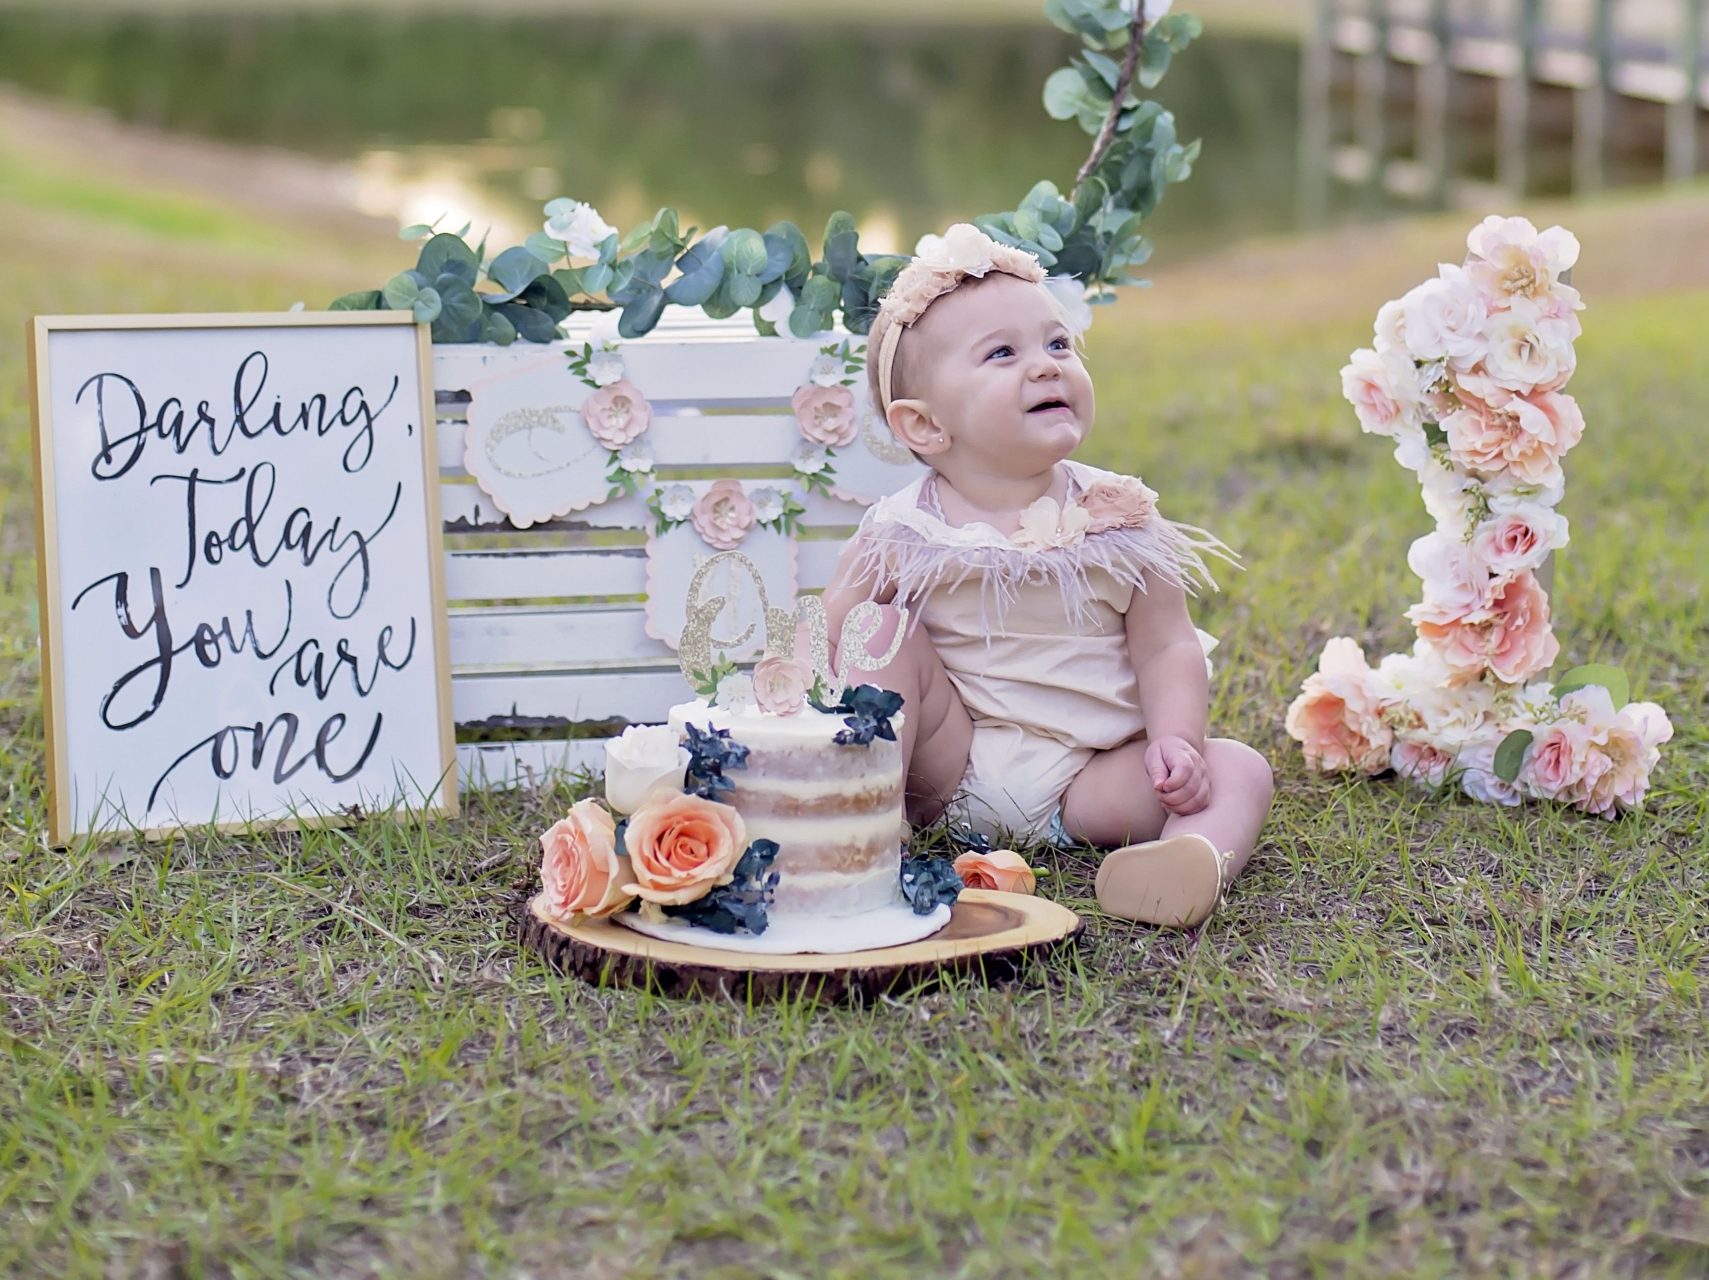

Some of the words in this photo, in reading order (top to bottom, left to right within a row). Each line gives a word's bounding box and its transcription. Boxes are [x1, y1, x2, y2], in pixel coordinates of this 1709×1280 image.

[75, 350, 414, 482] Darling,
[149, 461, 402, 620] Today
[71, 566, 293, 732] You
[269, 616, 416, 702] are
[146, 711, 384, 814] one
